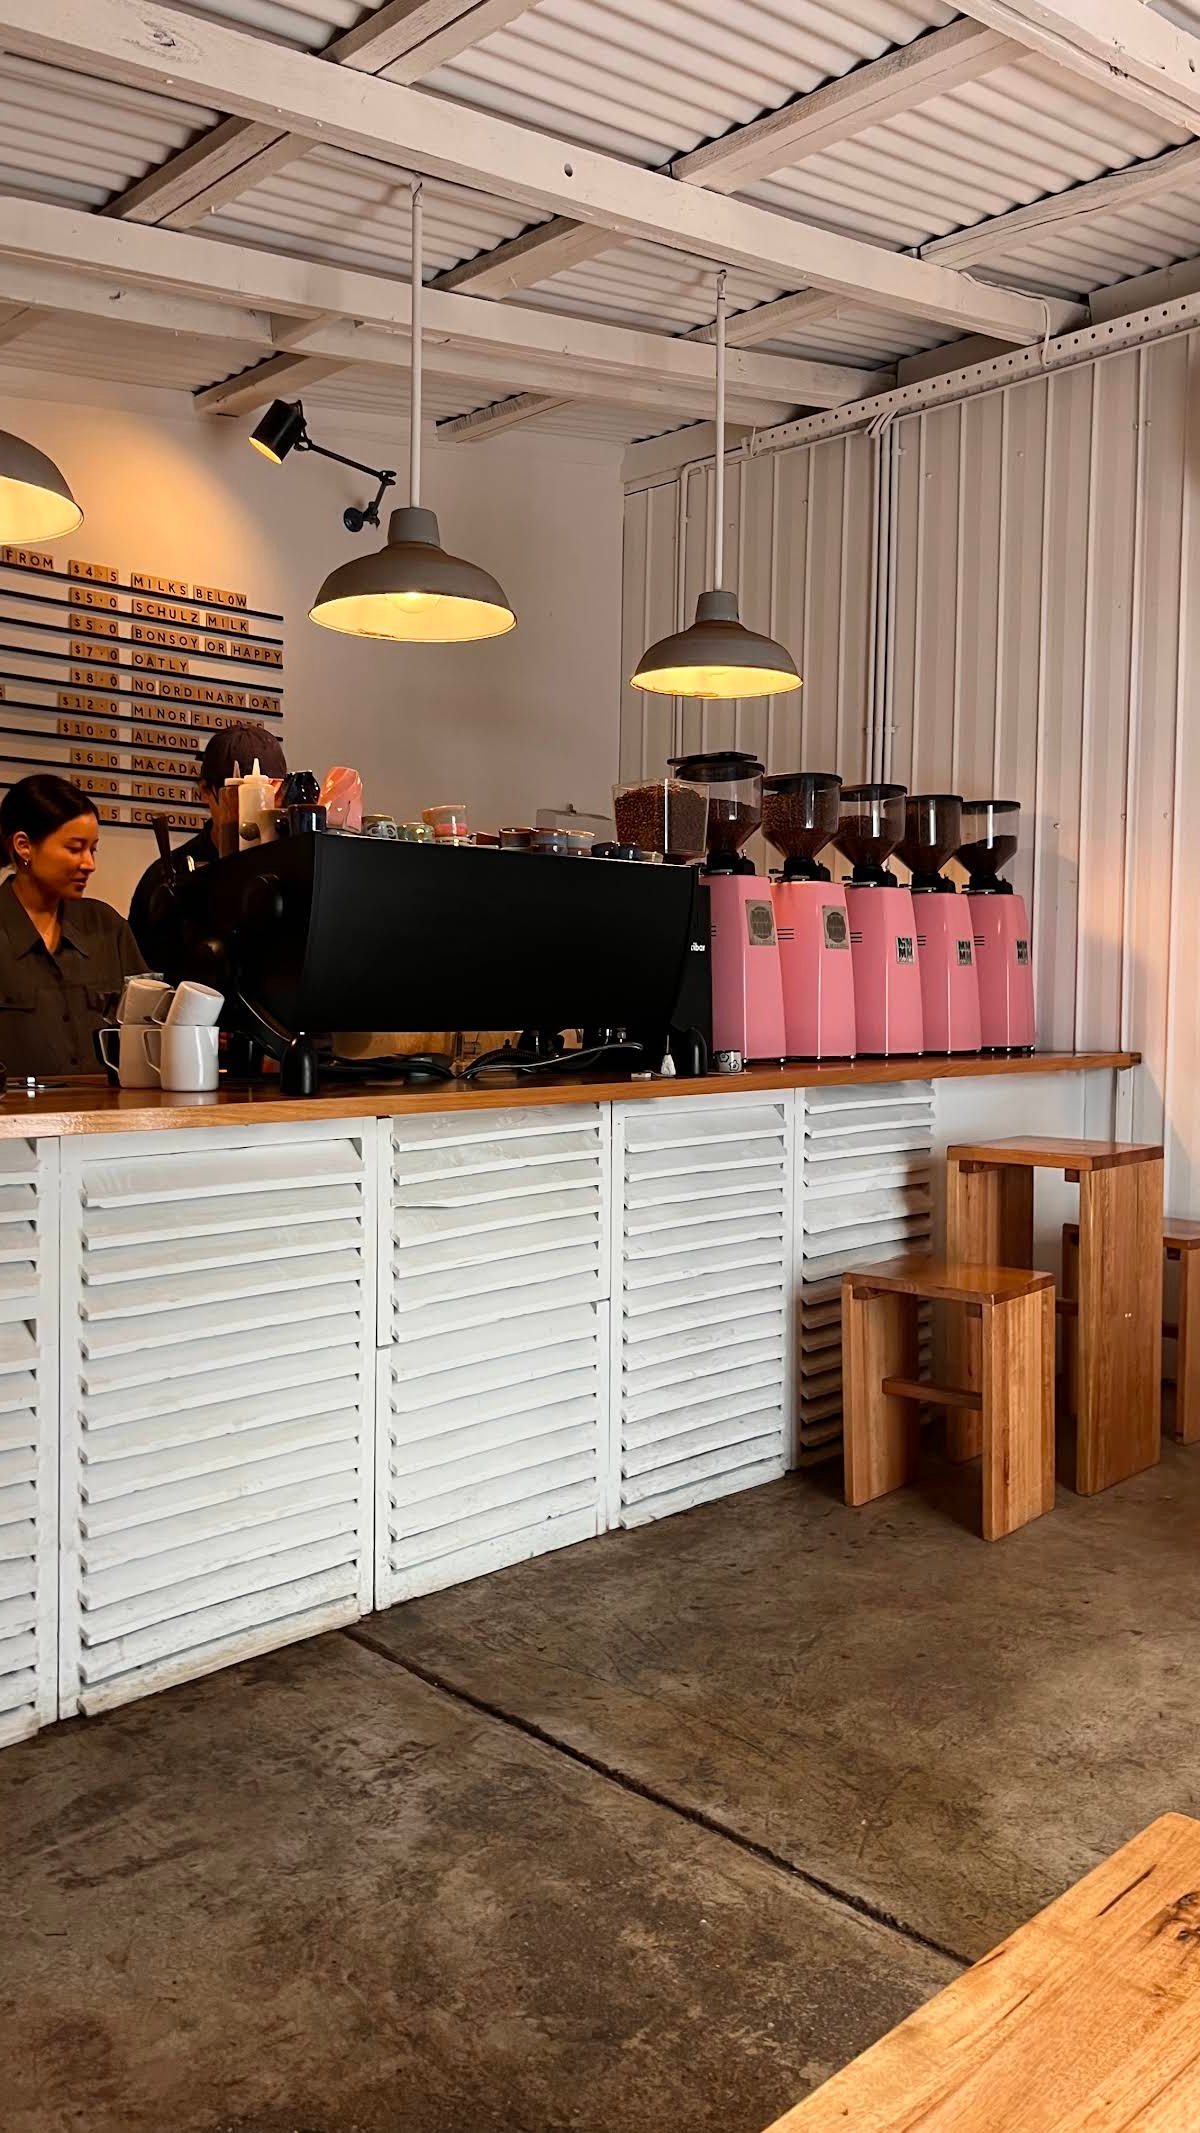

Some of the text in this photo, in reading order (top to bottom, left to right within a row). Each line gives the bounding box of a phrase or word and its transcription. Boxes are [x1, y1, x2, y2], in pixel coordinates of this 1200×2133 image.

[6, 549, 53, 569] FROM
[133, 575, 186, 595] MILKS
[196, 589, 247, 607] BELOW
[136, 603, 198, 623] SCHULZ
[208, 615, 247, 632] MILK
[135, 629, 197, 648] BONSOY
[207, 641, 224, 653] OR
[233, 646, 281, 663] HAPPY
[135, 655, 188, 672] OATLY
[135, 681, 155, 692] NO
[162, 685, 244, 703] ORDINARY
[251, 698, 279, 710] OAT
[134, 706, 186, 723] MINOR
[135, 733, 198, 748] ALMOND
[135, 784, 186, 800] TIGER
[134, 811, 207, 827] COONUT
